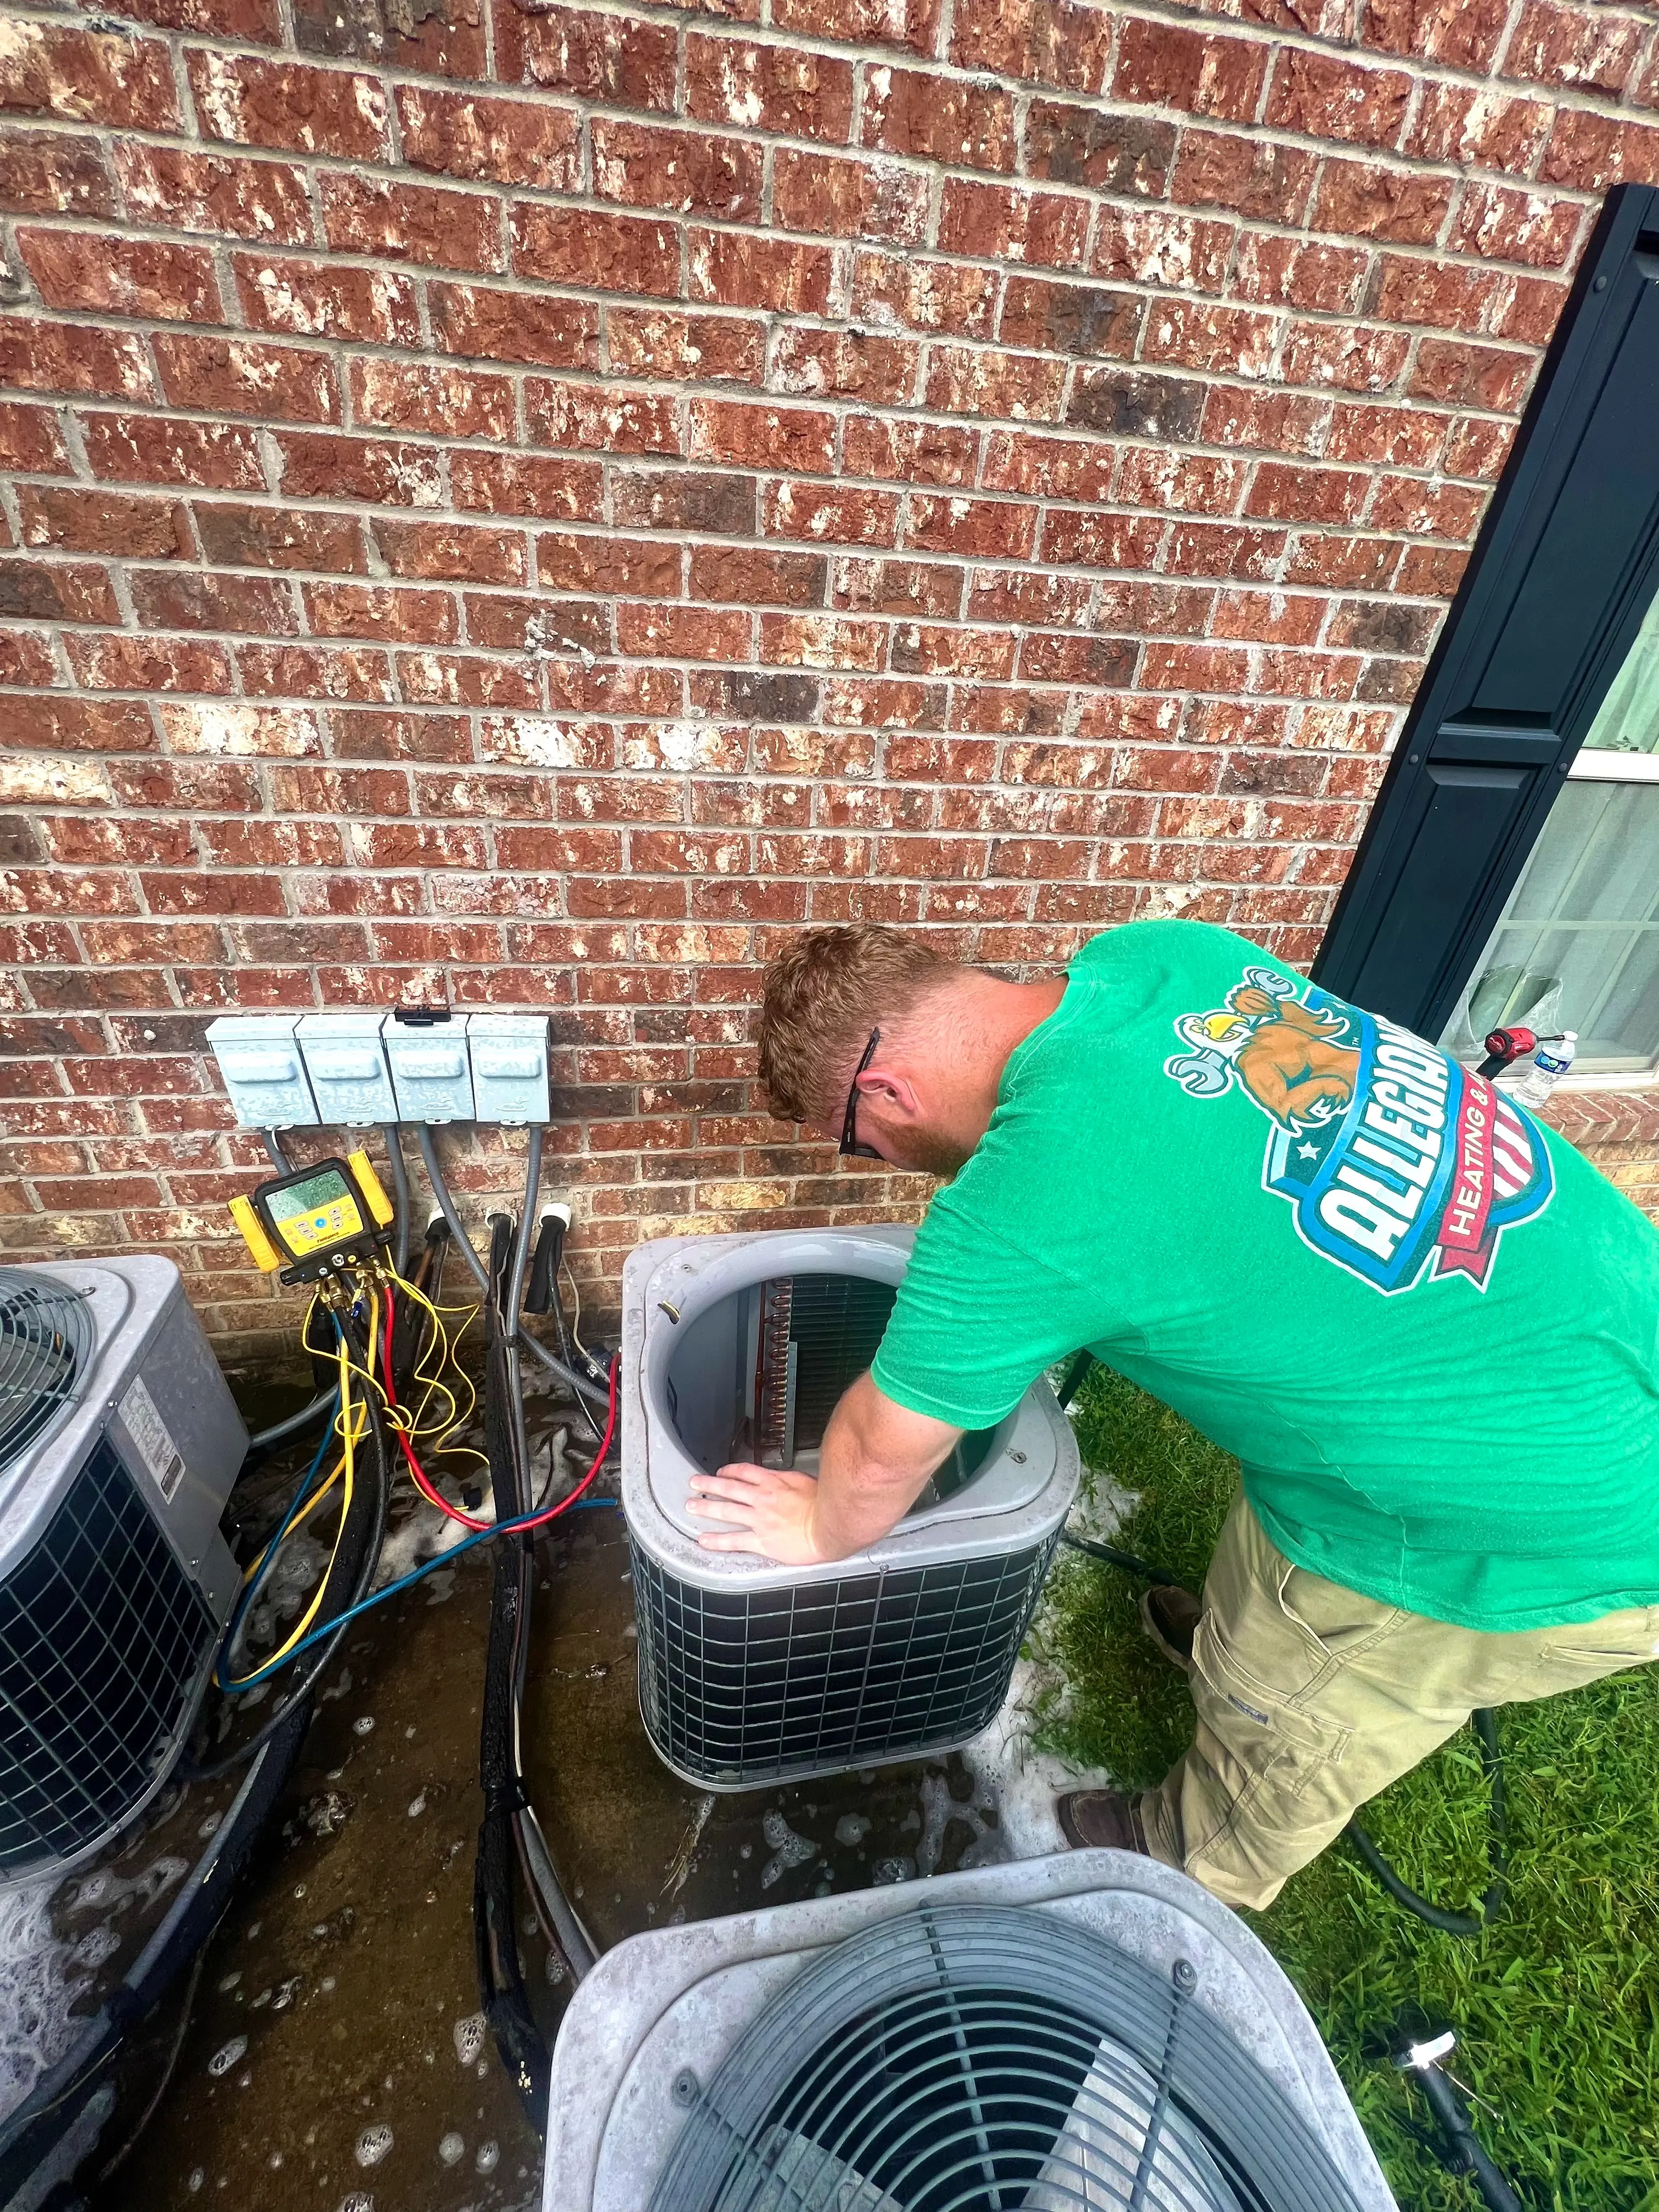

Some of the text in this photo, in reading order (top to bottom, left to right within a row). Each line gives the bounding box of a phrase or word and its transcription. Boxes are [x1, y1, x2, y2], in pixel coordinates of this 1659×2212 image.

[1352, 1036, 1359, 1046] TM
[1319, 1013, 1448, 1261] ALLEGIAN
[1448, 1106, 1486, 1236] HEATING
[1470, 1088, 1488, 1107] &
